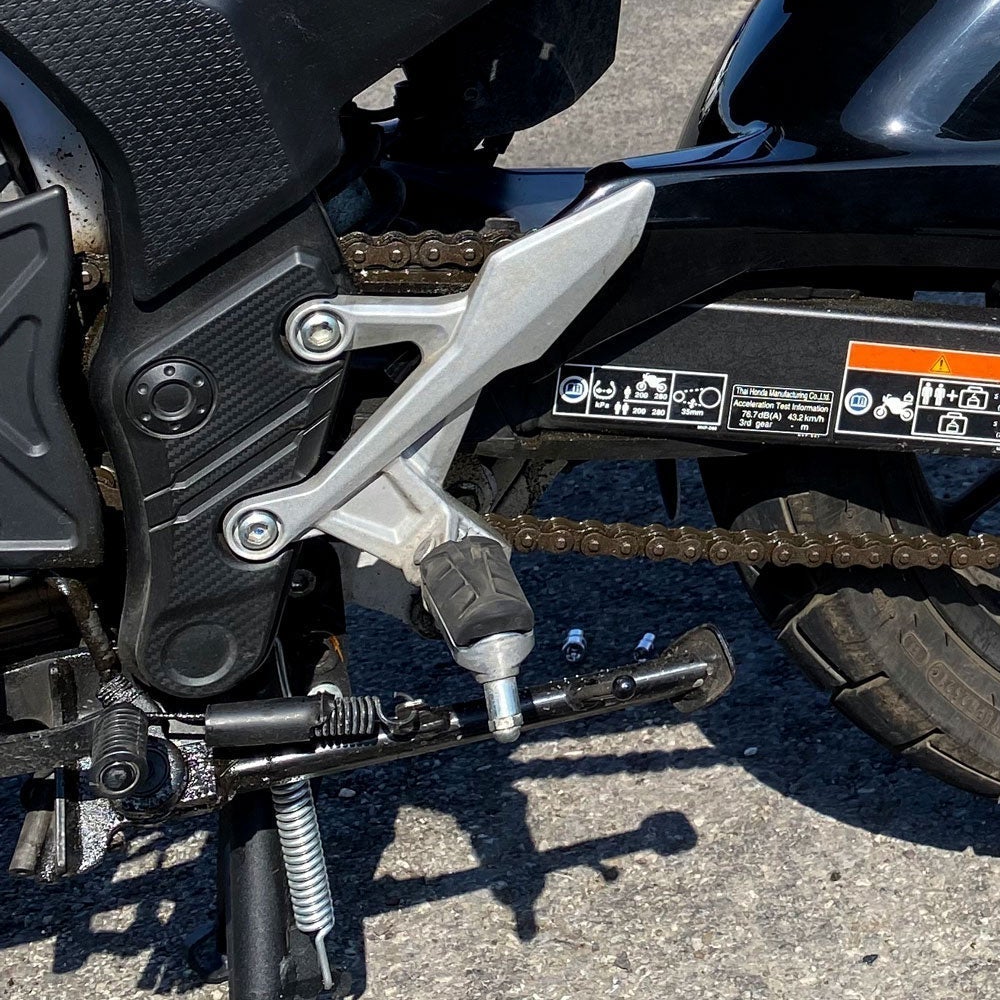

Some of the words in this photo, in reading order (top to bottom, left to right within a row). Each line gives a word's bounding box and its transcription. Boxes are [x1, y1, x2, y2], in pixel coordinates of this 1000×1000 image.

[736, 387, 748, 395] Thai
[749, 388, 768, 396] Honda
[769, 389, 808, 401] Manufacturing
[594, 401, 610, 409] kPa
[733, 399, 774, 409] Acceleration
[776, 402, 791, 410] Test
[792, 403, 829, 413] Information
[738, 419, 752, 427] 3rd
[755, 420, 773, 429] gear
